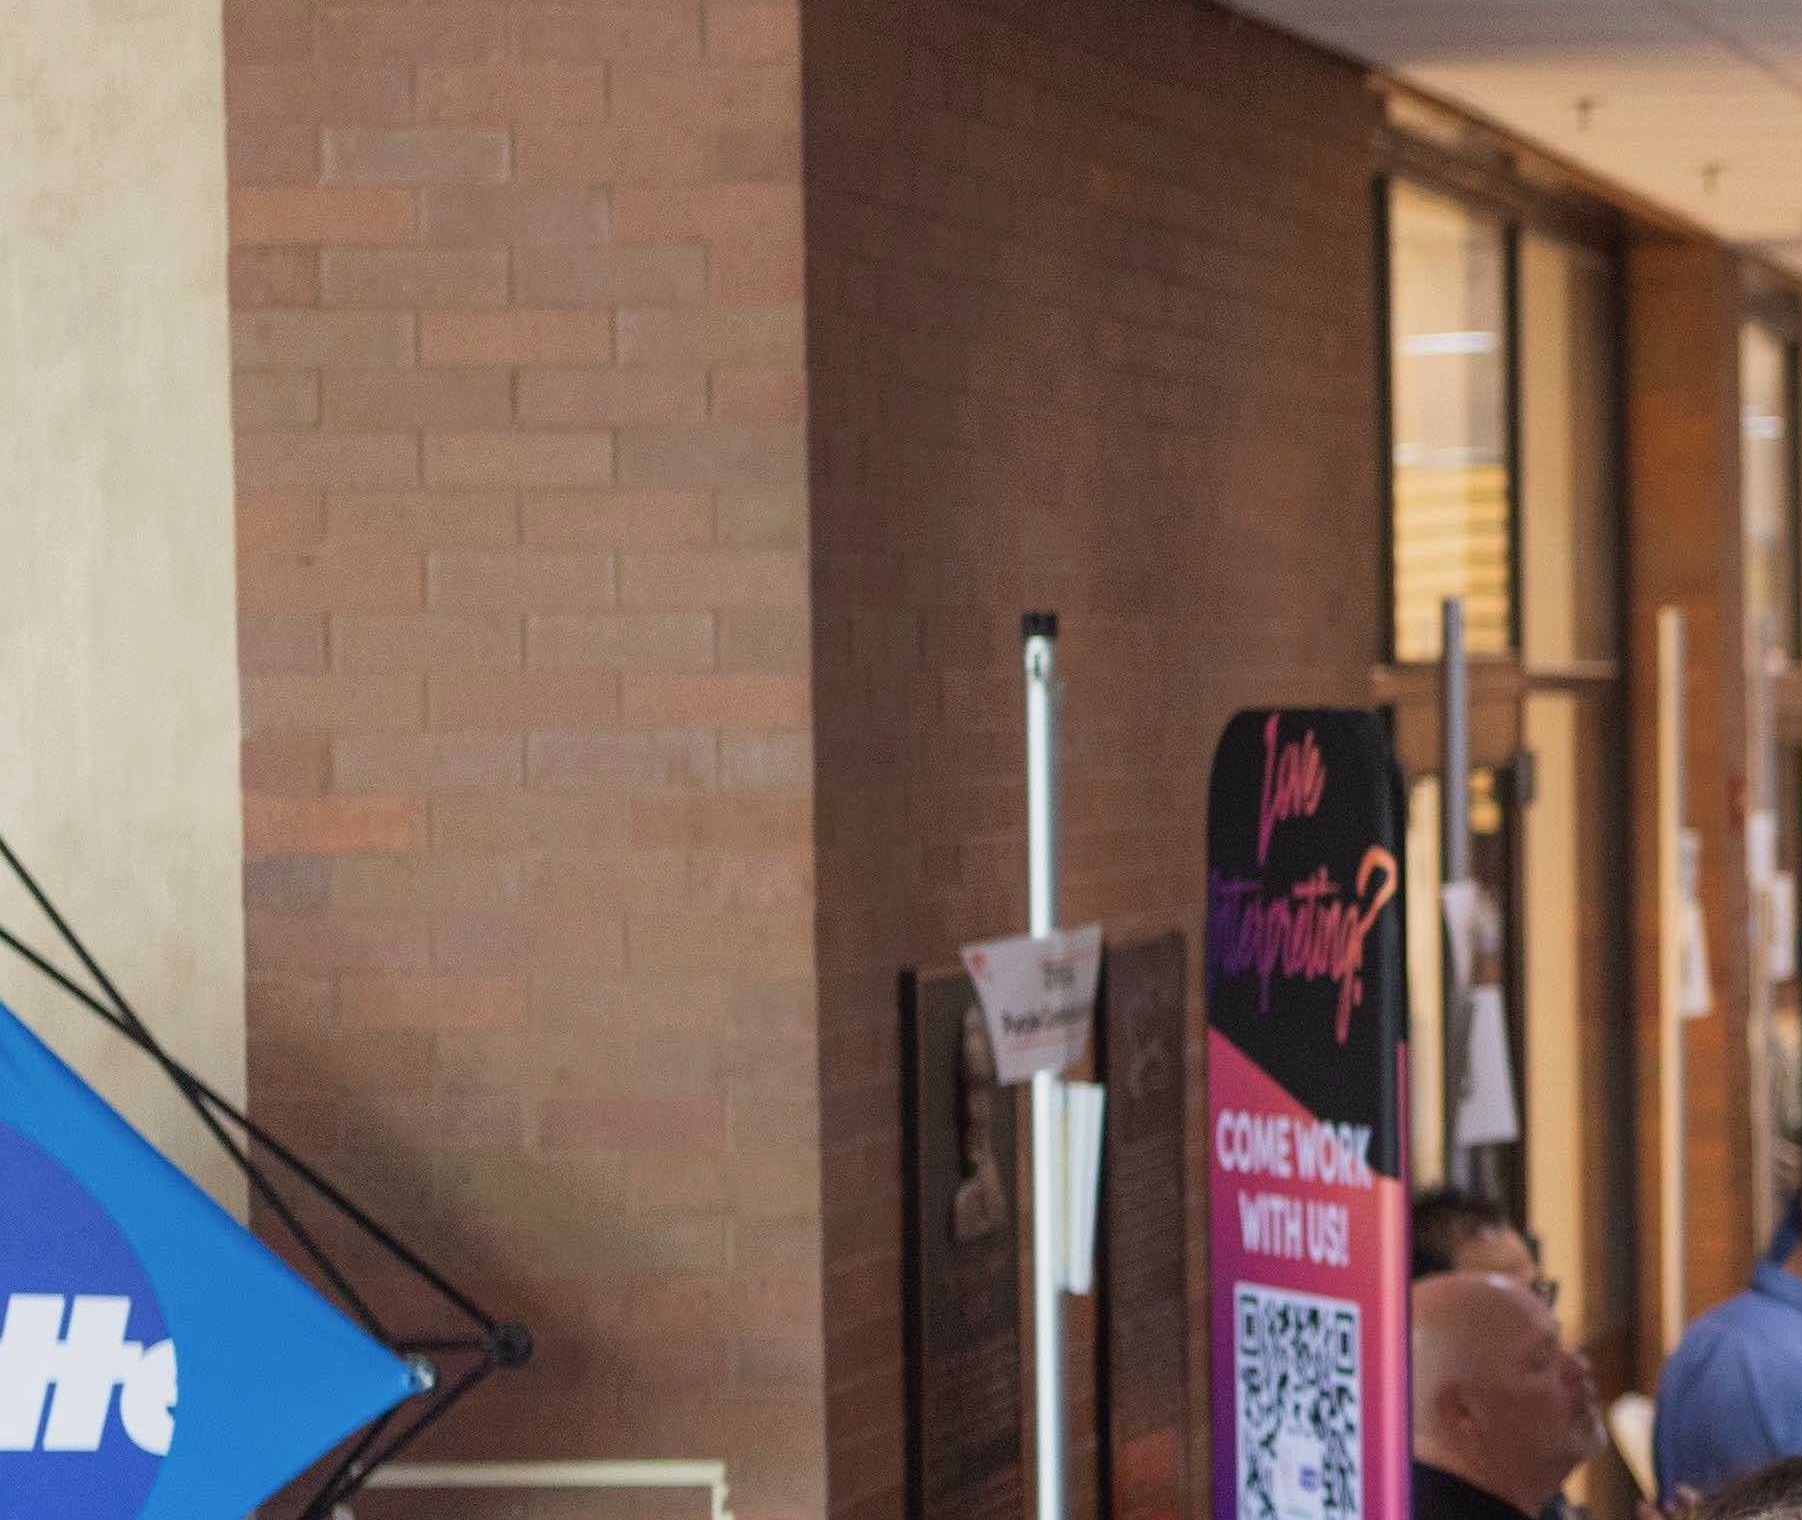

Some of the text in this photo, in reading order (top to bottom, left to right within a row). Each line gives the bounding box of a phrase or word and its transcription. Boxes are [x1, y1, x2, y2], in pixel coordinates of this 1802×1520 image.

[1216, 1108, 1374, 1190] COME WORK
[1237, 1190, 1350, 1268] WITH US!
